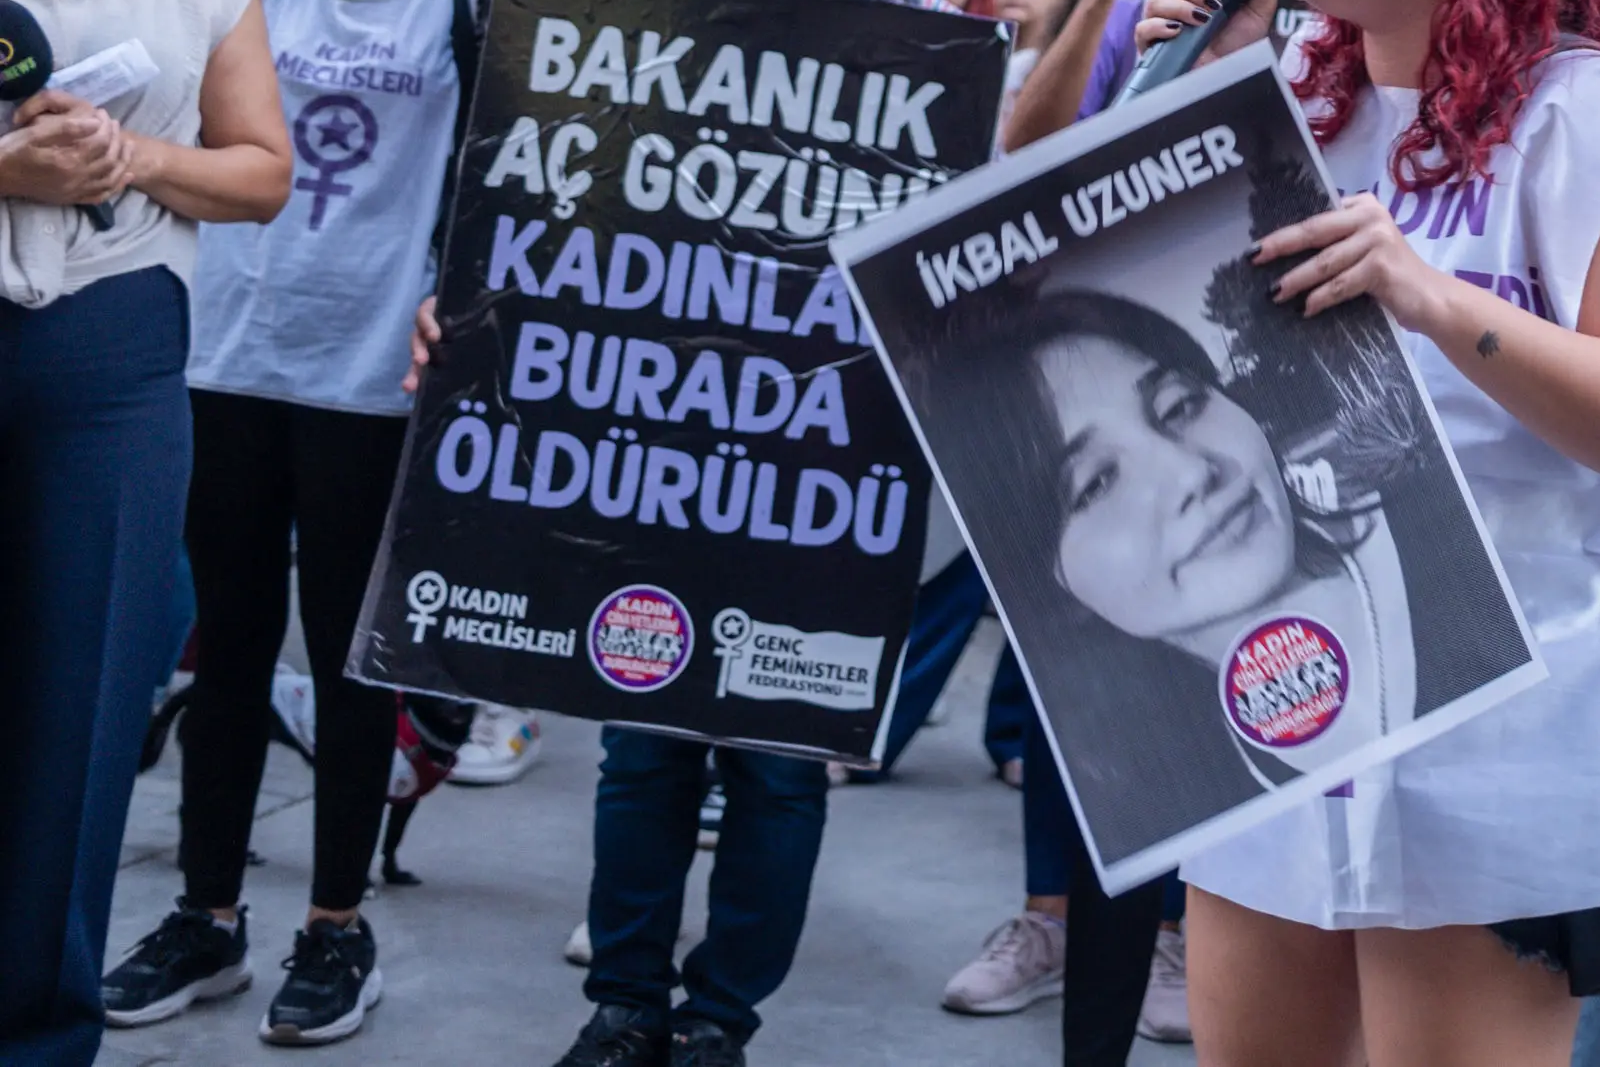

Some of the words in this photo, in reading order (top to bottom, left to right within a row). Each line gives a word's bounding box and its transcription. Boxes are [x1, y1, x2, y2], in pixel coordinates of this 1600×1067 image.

[528, 17, 946, 159] BAKANLIK
[484, 116, 598, 220] AÇ
[915, 212, 1059, 310] İKBAL
[1060, 124, 1244, 237] UZUNER
[487, 215, 876, 348] KADINLA
[509, 321, 850, 446] BURADA
[435, 399, 908, 555] ÖLDÜRÜLDÜ
[443, 615, 576, 658] MECLİSLERİ
[448, 585, 529, 619] KADIN
[748, 673, 843, 696] FEDERASYONU
